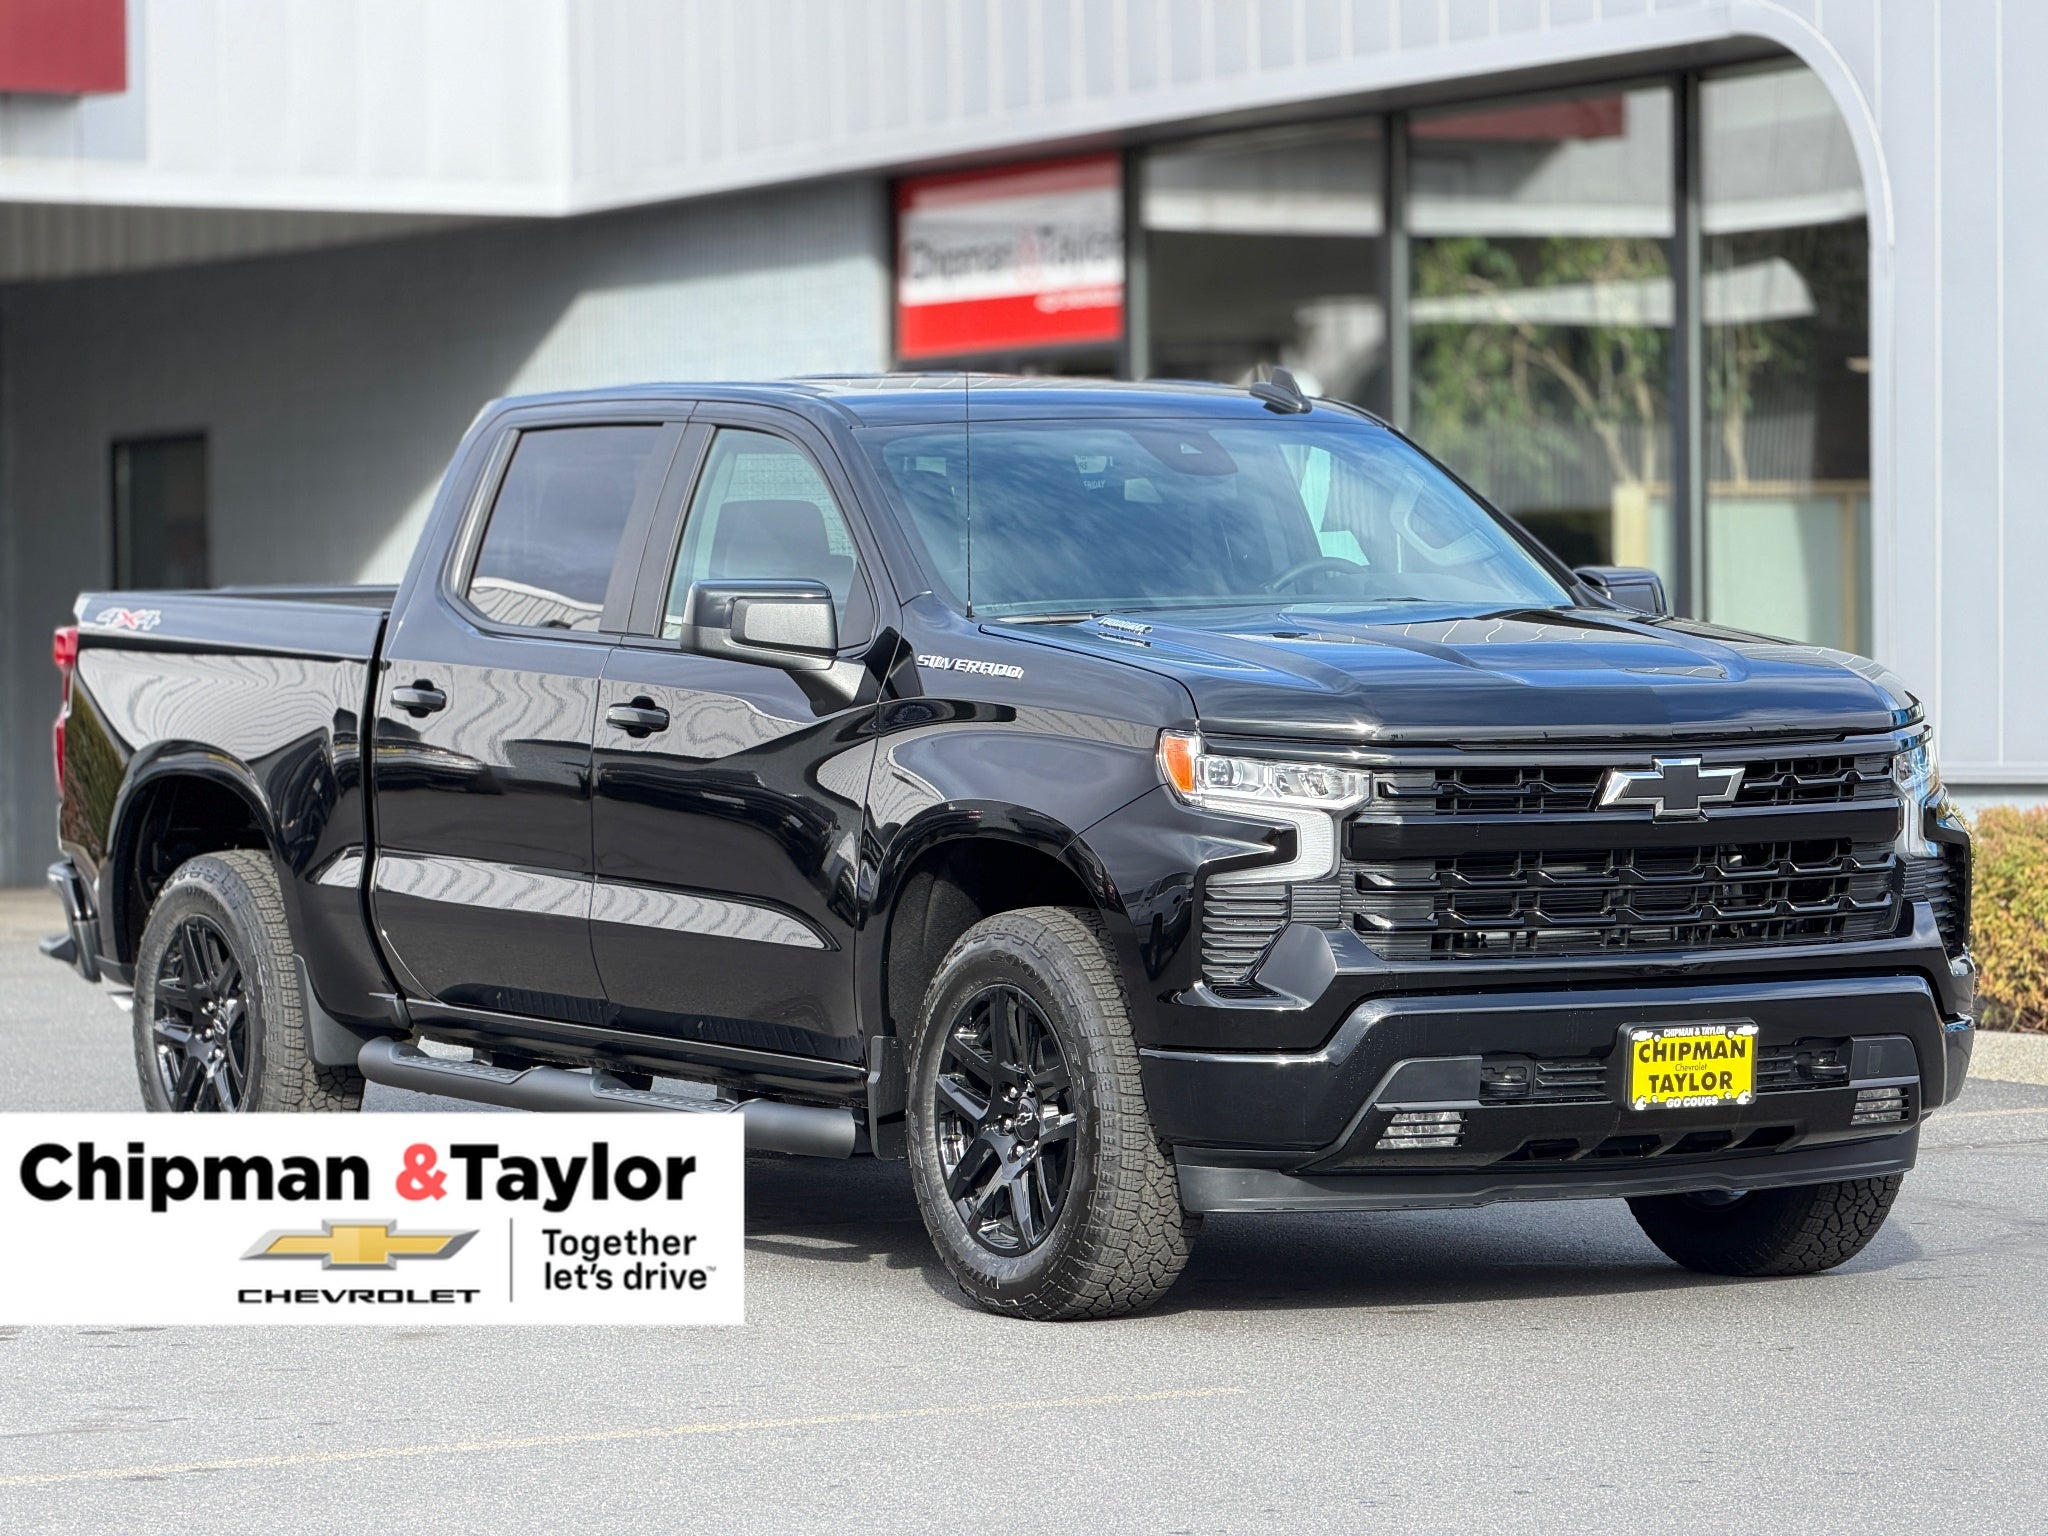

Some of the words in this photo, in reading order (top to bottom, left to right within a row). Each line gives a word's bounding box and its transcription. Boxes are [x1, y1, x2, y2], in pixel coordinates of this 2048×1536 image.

[917, 654, 1024, 679] SILVERADO
[1664, 1027, 1693, 1037] CHIPMAN
[1694, 1027, 1700, 1036] &
[1701, 1026, 1726, 1035] TAYLOR
[1638, 1040, 1746, 1063] CHIPMAN
[1675, 1062, 1708, 1072] Chevrolet
[1648, 1071, 1733, 1093] TAYLOR
[1666, 1098, 1682, 1108] GO
[1683, 1096, 1719, 1107] COUGS
